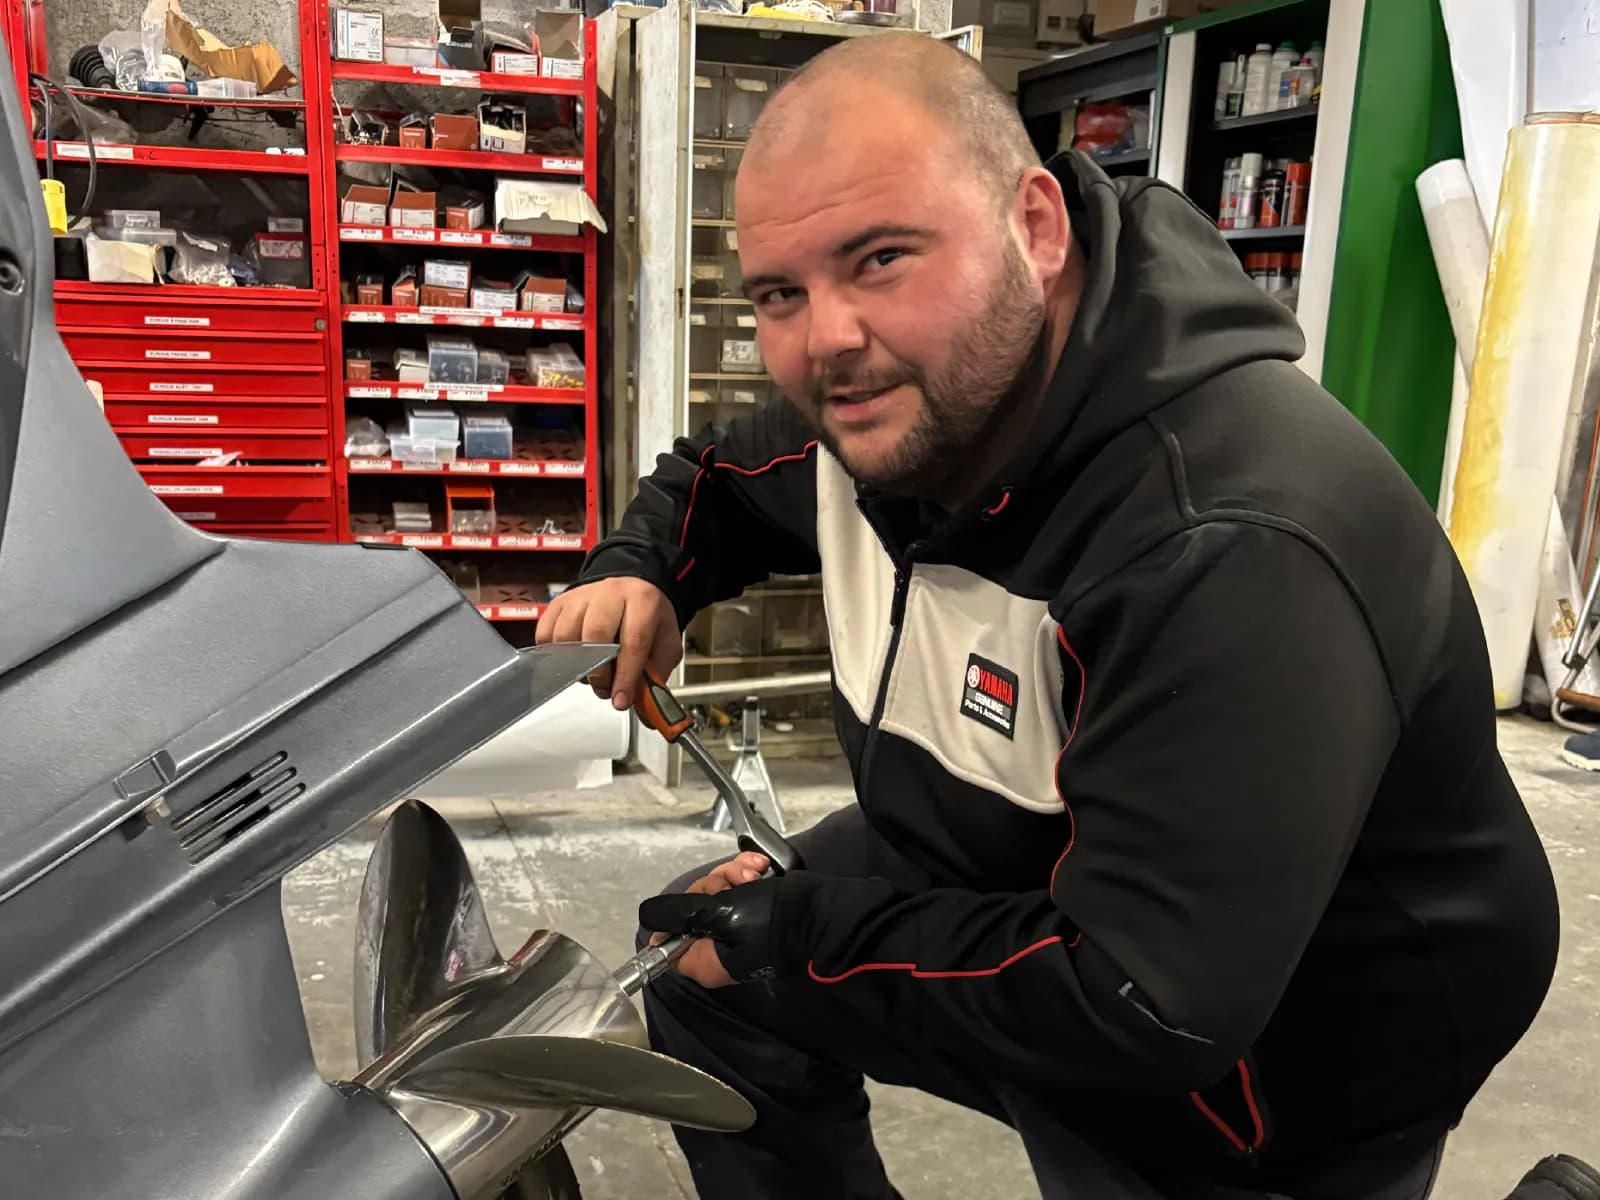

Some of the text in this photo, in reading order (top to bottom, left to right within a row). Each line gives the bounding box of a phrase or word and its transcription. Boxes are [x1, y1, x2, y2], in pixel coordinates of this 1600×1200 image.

[980, 670, 1013, 705] YAMAHA
[965, 699, 979, 712] Parts
[975, 692, 1003, 715] GENUINE
